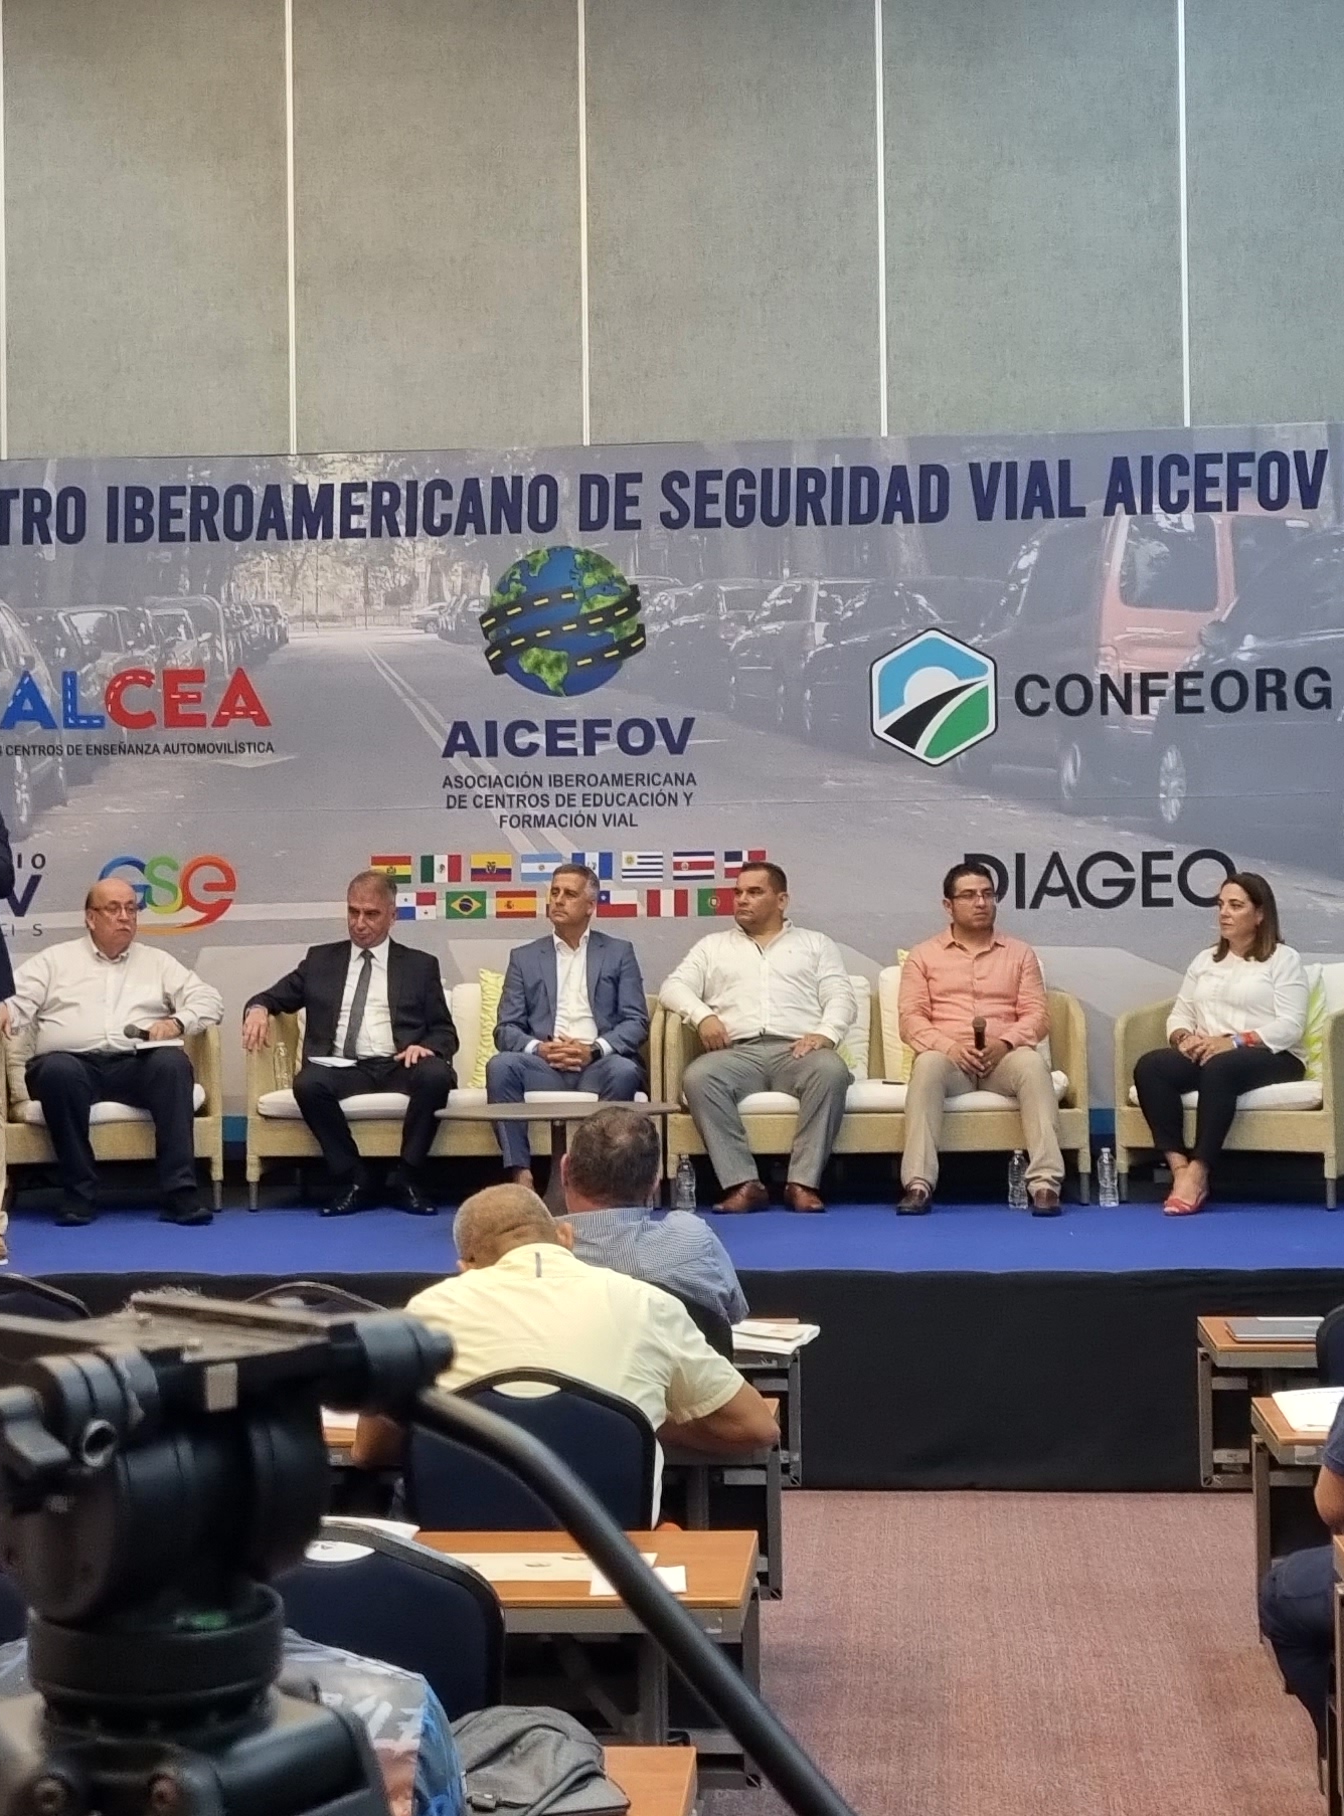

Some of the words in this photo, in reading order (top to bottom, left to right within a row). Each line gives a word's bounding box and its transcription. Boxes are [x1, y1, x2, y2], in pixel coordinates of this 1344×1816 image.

[106, 473, 558, 544] IBEROAMERICANO
[579, 472, 643, 532] DE
[659, 464, 950, 530] SEGURIDAD
[968, 459, 1087, 521] VIAL
[1103, 449, 1329, 516] AICEFOV
[1014, 666, 1333, 717] CONFEORG
[5, 744, 63, 757] CENTROS
[67, 744, 83, 756] DE
[86, 740, 160, 755] ENSEÑANZA
[163, 739, 274, 755] AUTOMOVILÍSTICA
[441, 717, 696, 758] AICEFOV
[442, 771, 543, 789] ASOCIACIÓN
[549, 772, 697, 788] IBEROAMERICANA
[446, 794, 468, 809] DE
[473, 793, 550, 809] CENTROS
[556, 793, 576, 808] DE
[582, 789, 678, 808] EDUCACIÓN
[683, 792, 694, 807] Y
[499, 810, 597, 829] FORMACIÓN
[602, 813, 638, 828] VIAL
[964, 848, 1237, 910] DIAGEO
